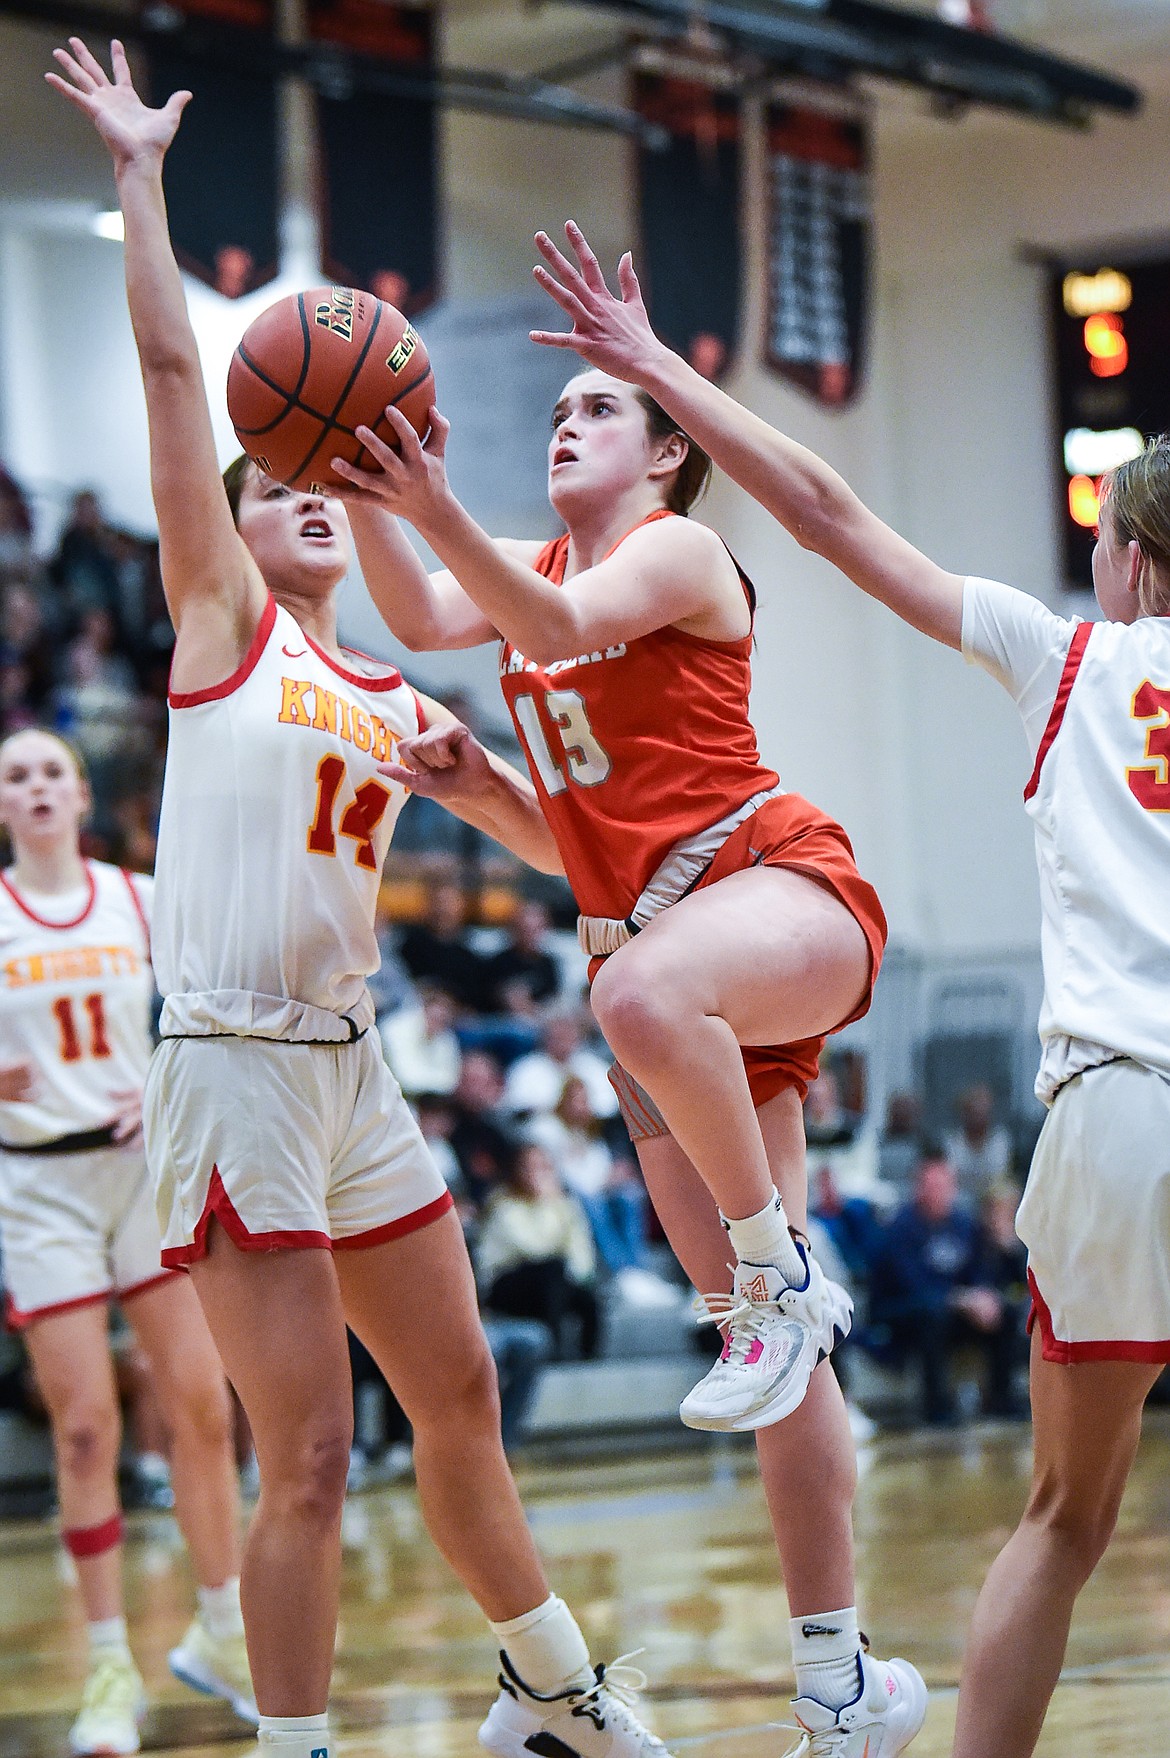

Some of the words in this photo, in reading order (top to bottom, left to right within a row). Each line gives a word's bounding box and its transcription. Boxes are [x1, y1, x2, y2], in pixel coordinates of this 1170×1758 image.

[278, 676, 408, 785] KNIGH
[514, 688, 614, 797] 13
[307, 751, 393, 873] 14
[52, 992, 112, 1063] 11
